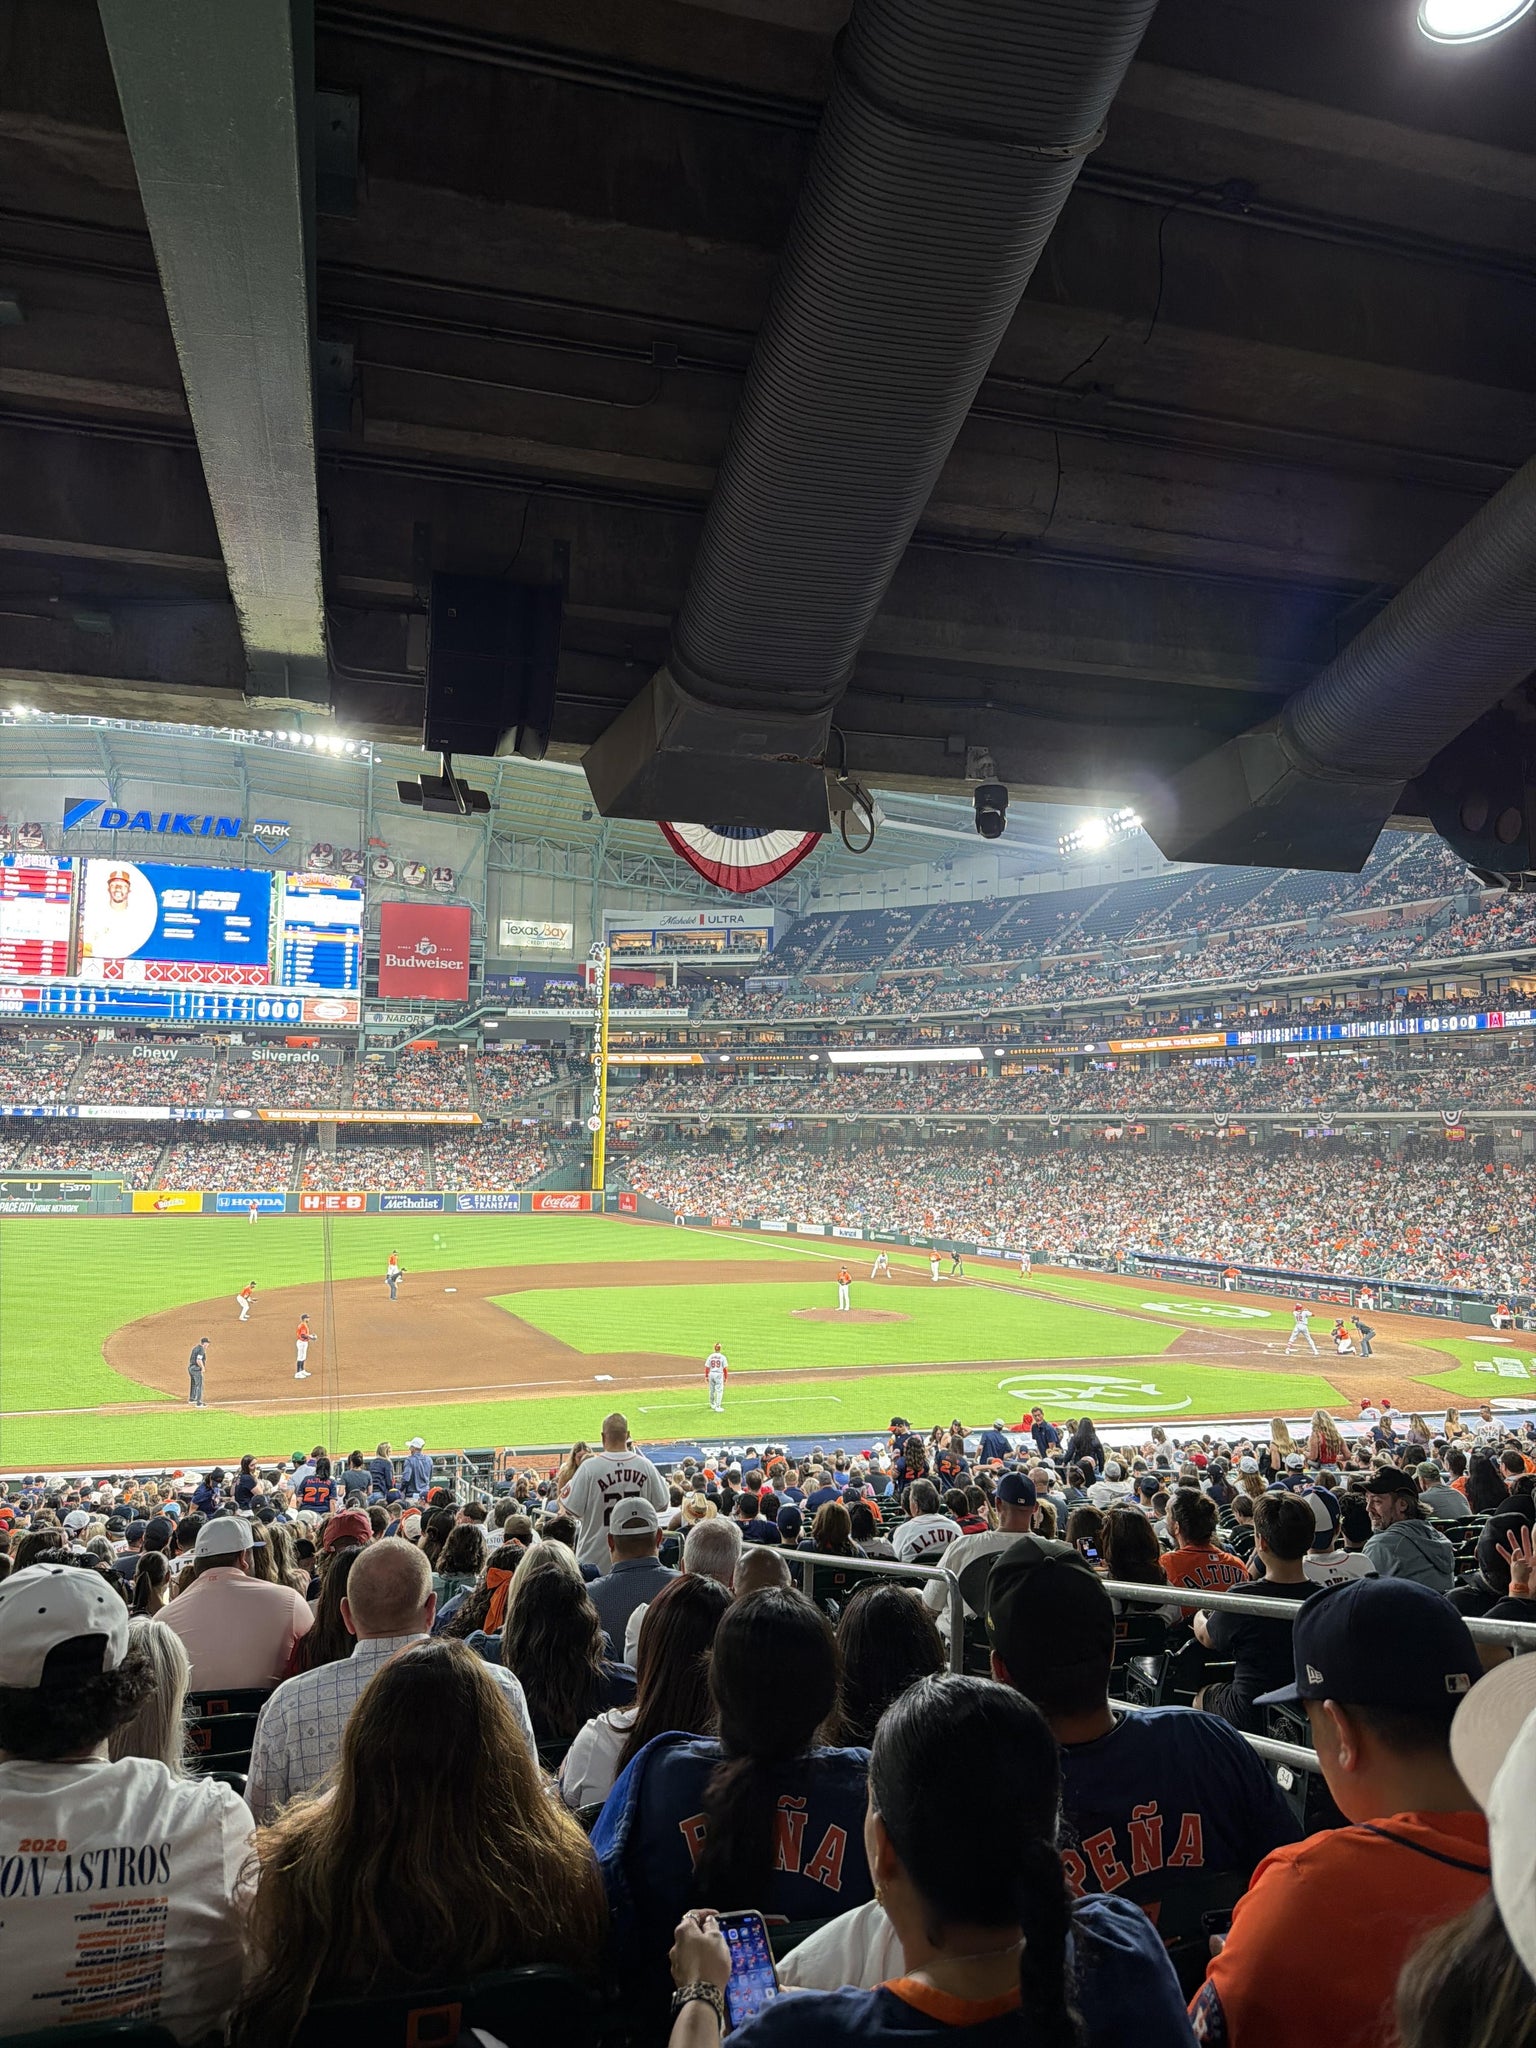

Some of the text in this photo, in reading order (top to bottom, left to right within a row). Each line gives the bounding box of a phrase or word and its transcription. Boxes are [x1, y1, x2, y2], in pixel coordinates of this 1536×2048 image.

[18, 822, 42, 838] 42
[100, 808, 242, 838] DAIKIN
[253, 823, 291, 837] PARK
[312, 843, 332, 858] 49
[342, 849, 365, 862] 24
[378, 856, 388, 868] 5
[409, 862, 419, 875] 7
[434, 868, 452, 881] 13
[708, 915, 744, 924] ULTRA
[505, 922, 568, 940] Texas Bay
[385, 954, 464, 970] Budweiser.
[258, 1002, 270, 1018] 0
[272, 1002, 284, 1018] 0
[287, 1002, 299, 1018] 0
[386, 1015, 426, 1024] NABORS
[594, 1023, 602, 1052] THA
[132, 1046, 178, 1060] Chevy
[252, 1050, 320, 1062] Silverado
[592, 1056, 602, 1114] CHIKIN
[18, 1202, 36, 1212] CITY
[304, 1196, 362, 1208] H-E-B
[384, 1198, 438, 1209] Methodist
[598, 1469, 648, 1492] ALTUVE
[304, 1487, 330, 1502] 27
[911, 1528, 959, 1554] ALTUV
[1182, 1564, 1249, 1588] ALTUV
[1280, 1770, 1290, 1784] 34
[1061, 1801, 1204, 1898] PEÑA
[0, 1842, 172, 1898] ON ASTROS
